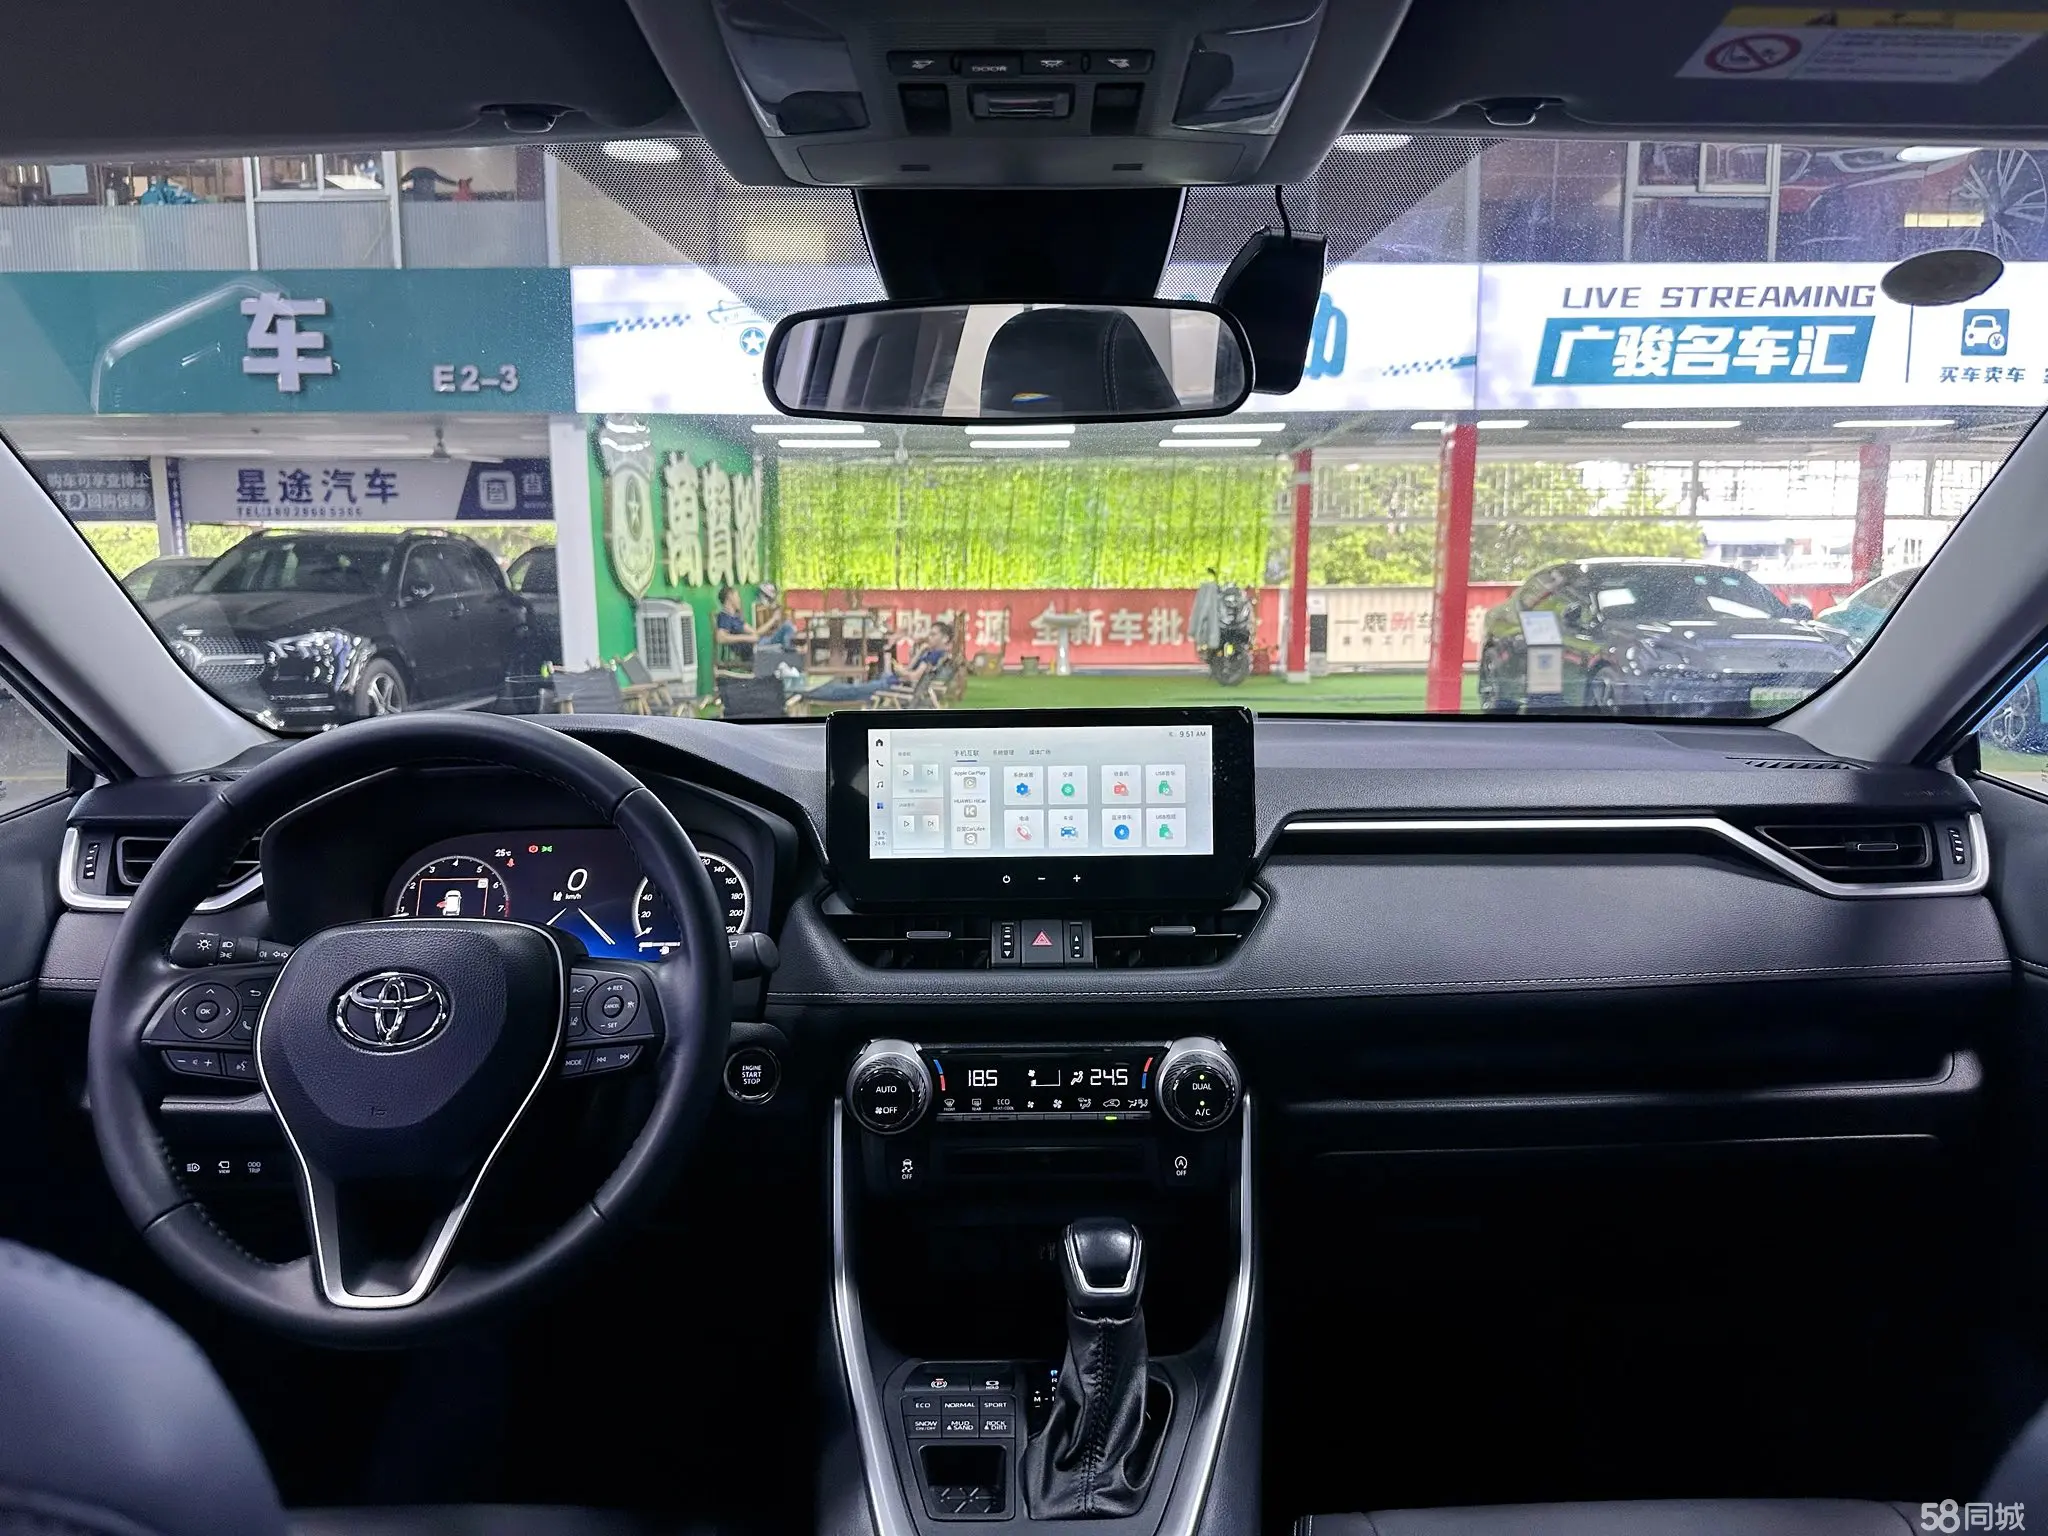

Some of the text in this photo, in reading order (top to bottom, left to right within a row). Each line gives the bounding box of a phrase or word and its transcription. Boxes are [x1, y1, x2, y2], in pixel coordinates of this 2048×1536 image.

[1562, 284, 1876, 309] LIVE STREAMING
[240, 291, 333, 393] 车
[1551, 324, 1857, 378] 广骏名车汇
[1939, 366, 2026, 383] 买车卖车
[237, 468, 399, 504] 星途汽车
[1030, 606, 1196, 645] 全新车批
[701, 858, 711, 866] 20
[429, 866, 436, 874] 3
[713, 865, 725, 873] 140
[567, 868, 588, 892] 0
[725, 877, 737, 885] 160
[410, 882, 416, 890] 2
[493, 881, 500, 889] 6
[729, 909, 743, 917] 200
[725, 926, 736, 934] 20
[968, 1069, 998, 1088] 18.5
[1090, 1068, 1128, 1087] 24.5
[875, 1085, 898, 1093] AUTO
[1192, 1082, 1212, 1091] DUAL
[882, 1106, 898, 1114] OFF
[1194, 1108, 1211, 1117] A/C
